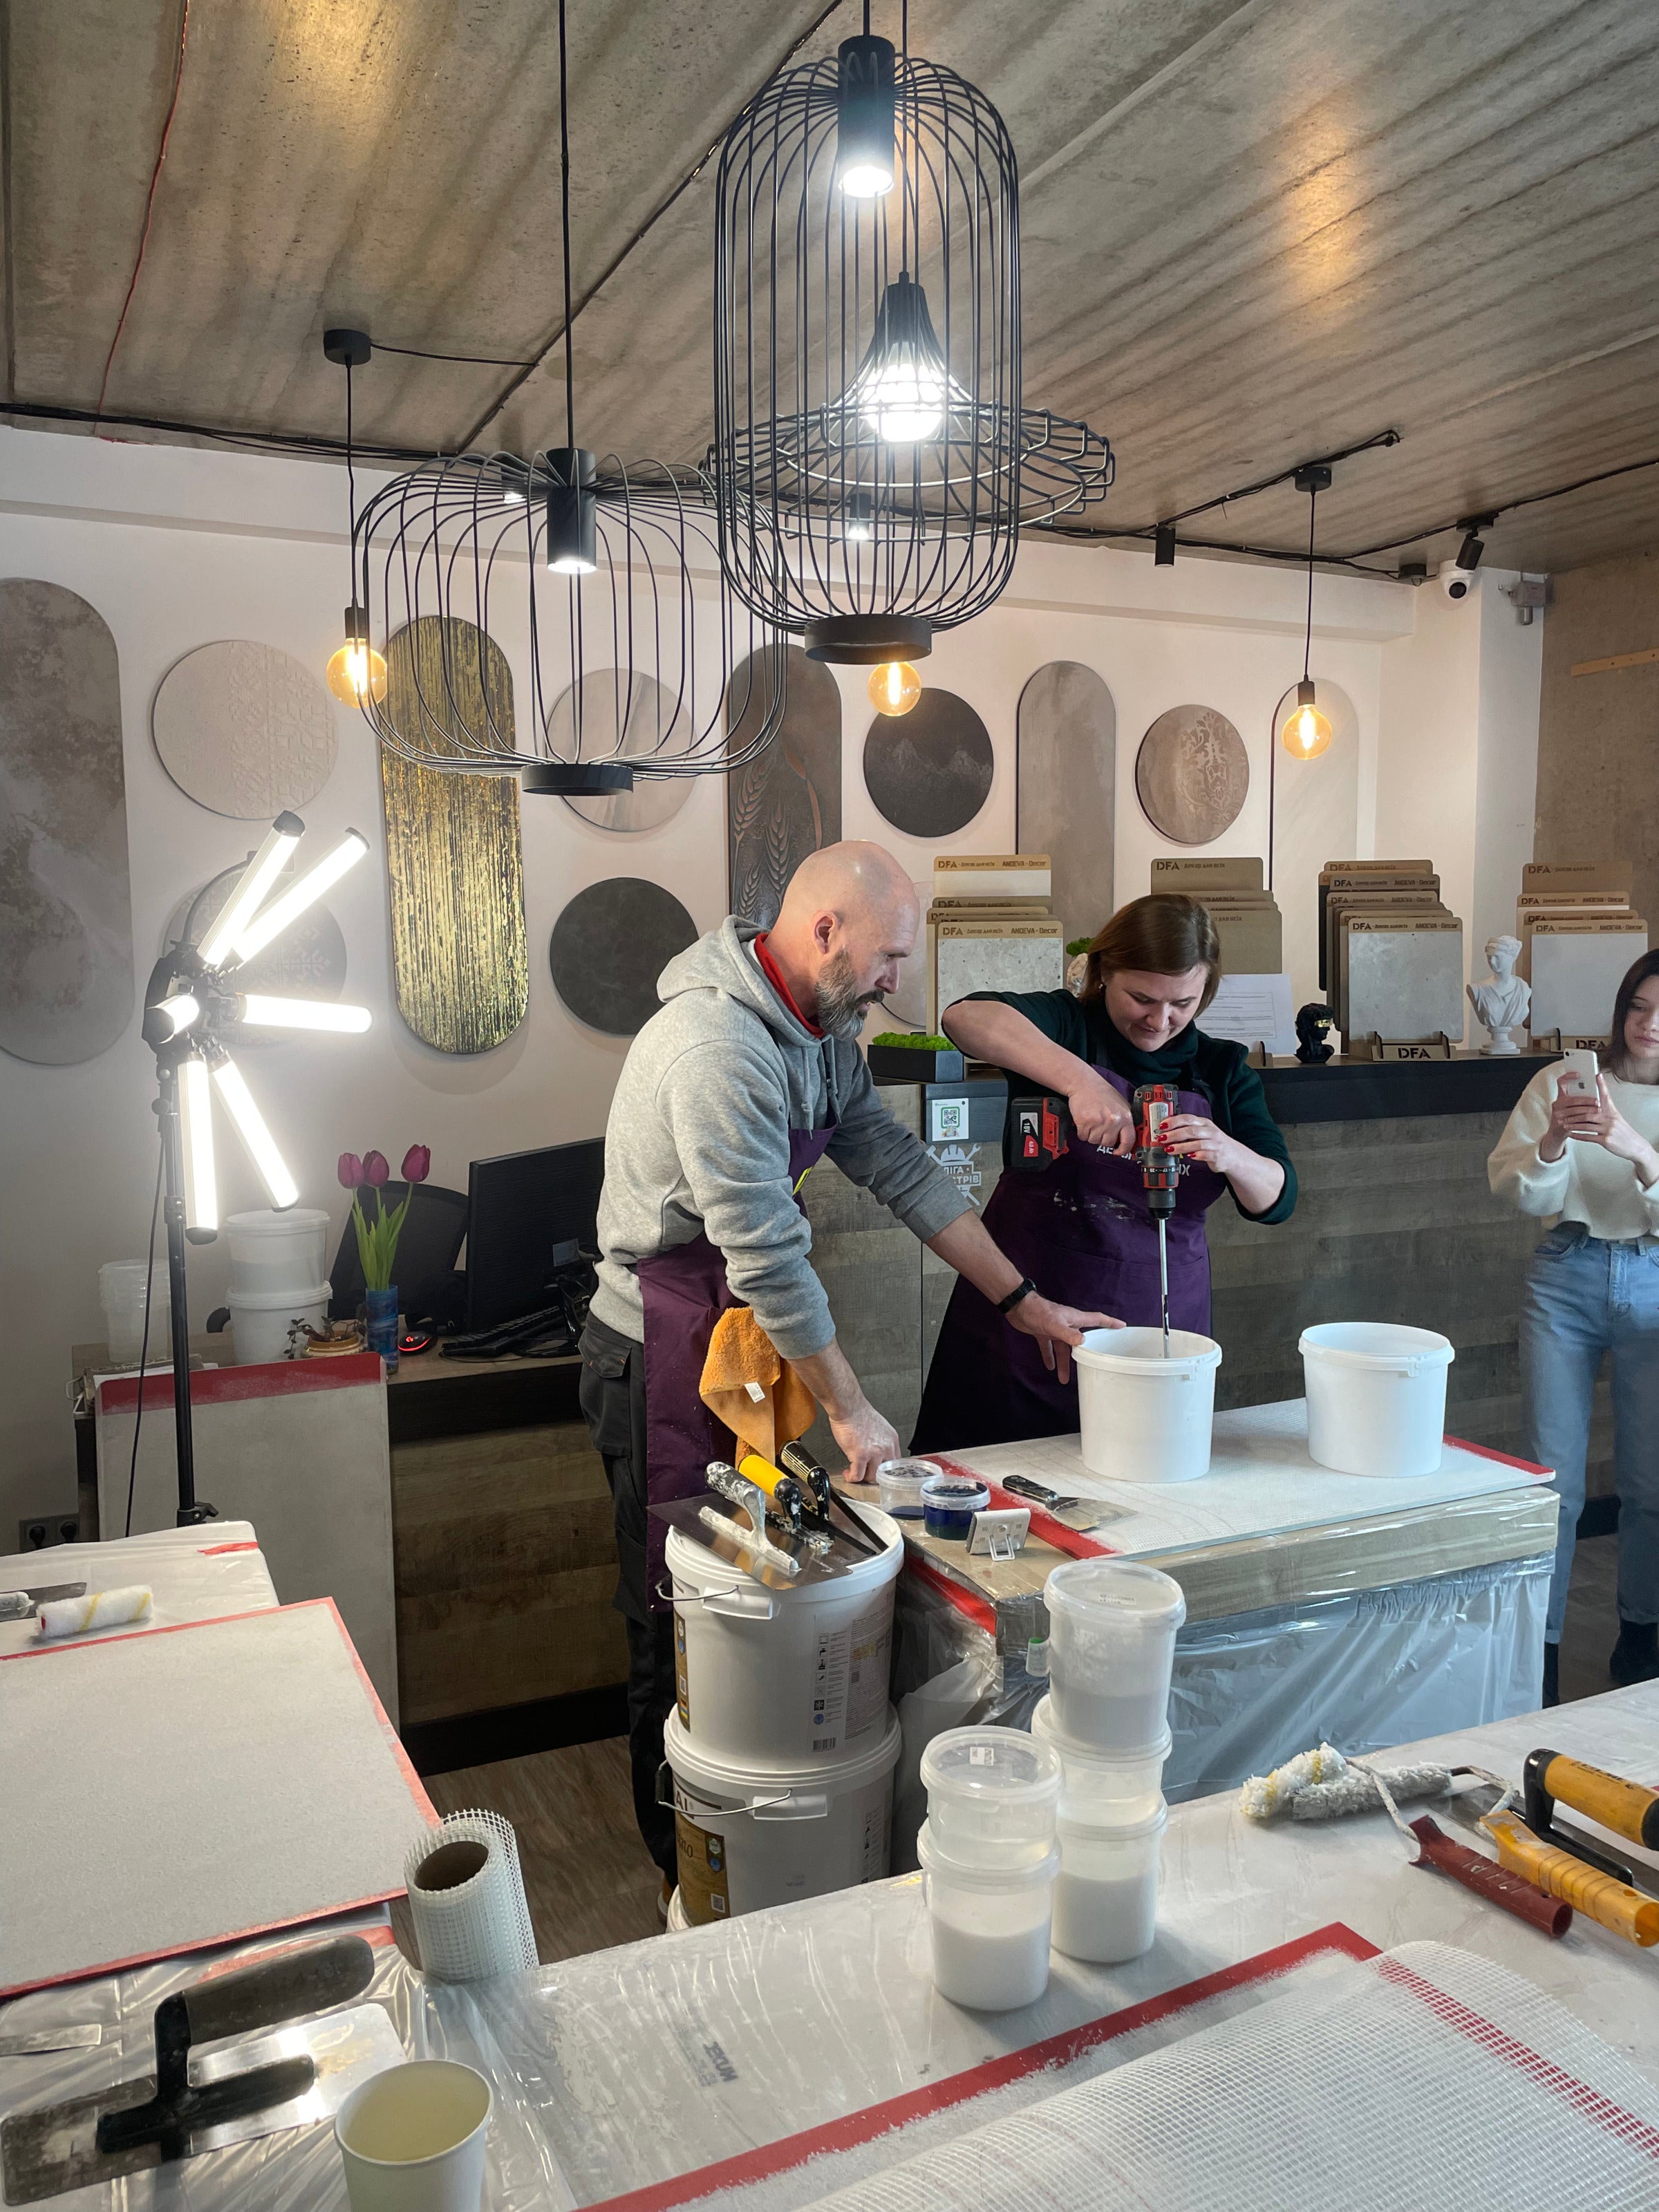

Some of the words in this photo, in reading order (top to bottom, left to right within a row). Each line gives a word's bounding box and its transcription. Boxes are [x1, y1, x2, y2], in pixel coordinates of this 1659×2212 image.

[1156, 861, 1179, 870] DFA
[1528, 865, 1550, 874] DFA
[1398, 1047, 1432, 1058] DFA
